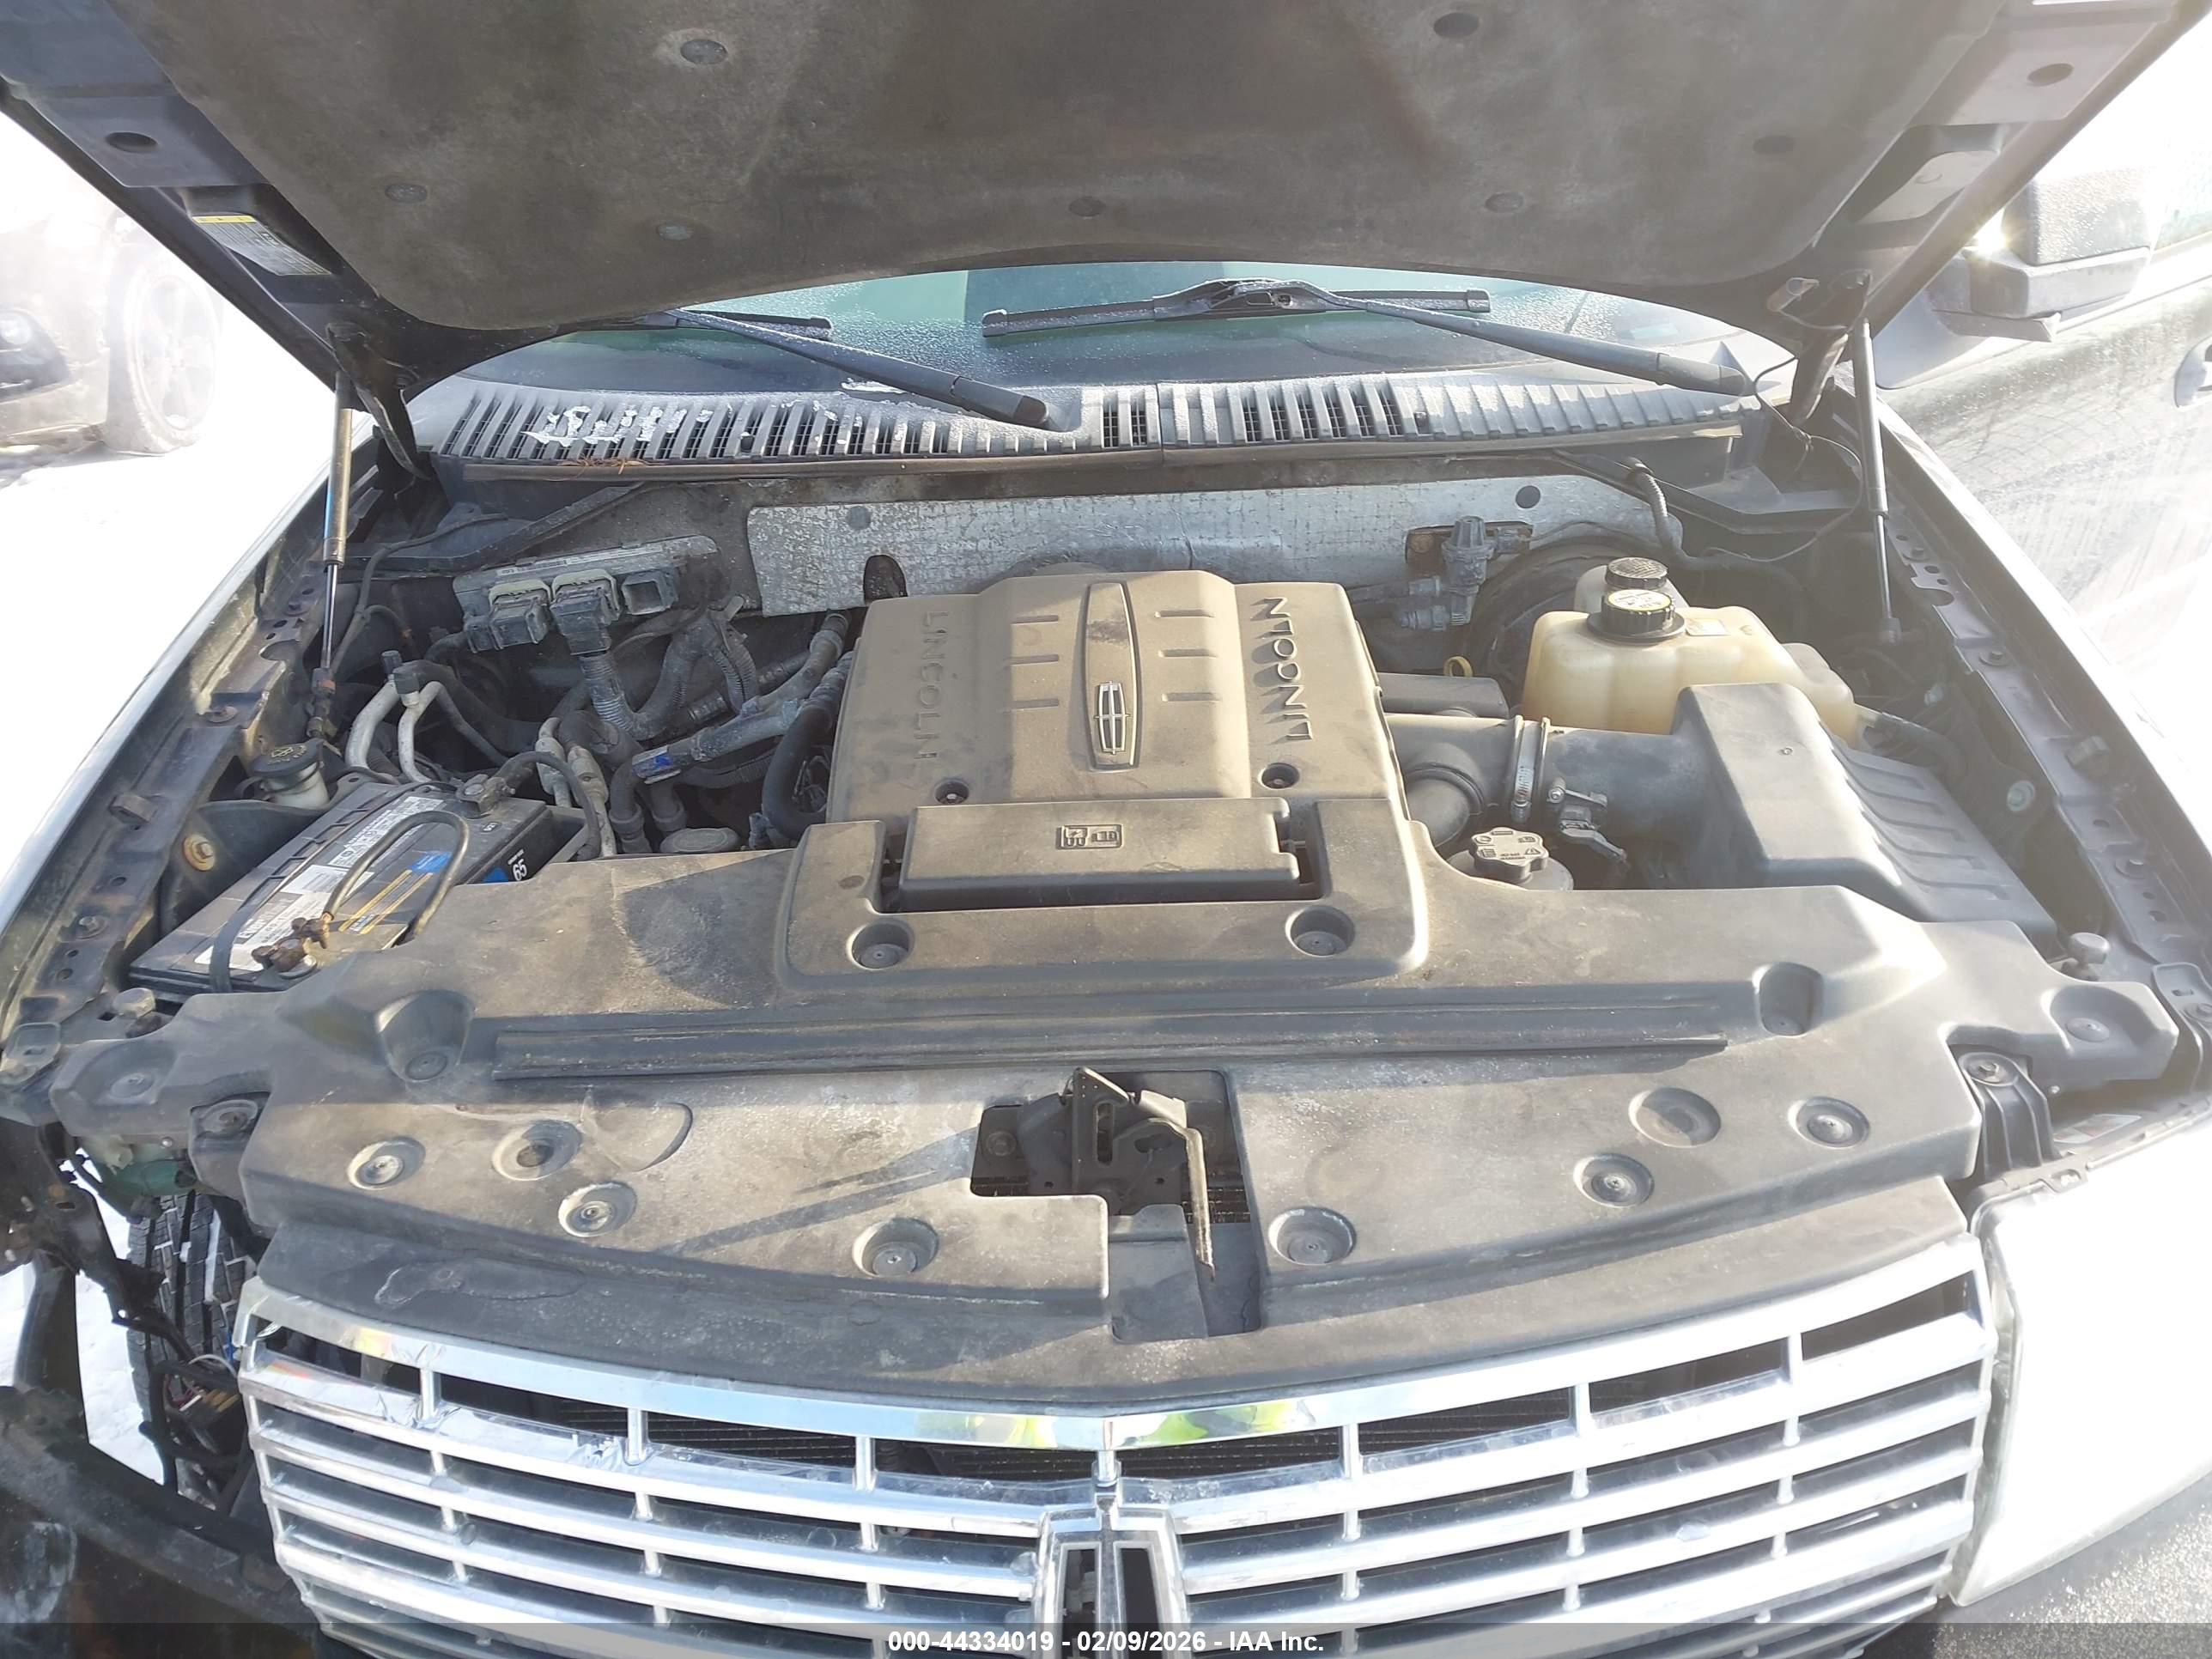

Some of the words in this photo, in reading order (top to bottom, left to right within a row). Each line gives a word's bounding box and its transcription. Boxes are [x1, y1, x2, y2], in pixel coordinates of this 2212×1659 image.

[913, 611, 949, 760] LINCOLN
[1262, 596, 1314, 741] LINCOLN
[512, 858, 528, 881] 65
